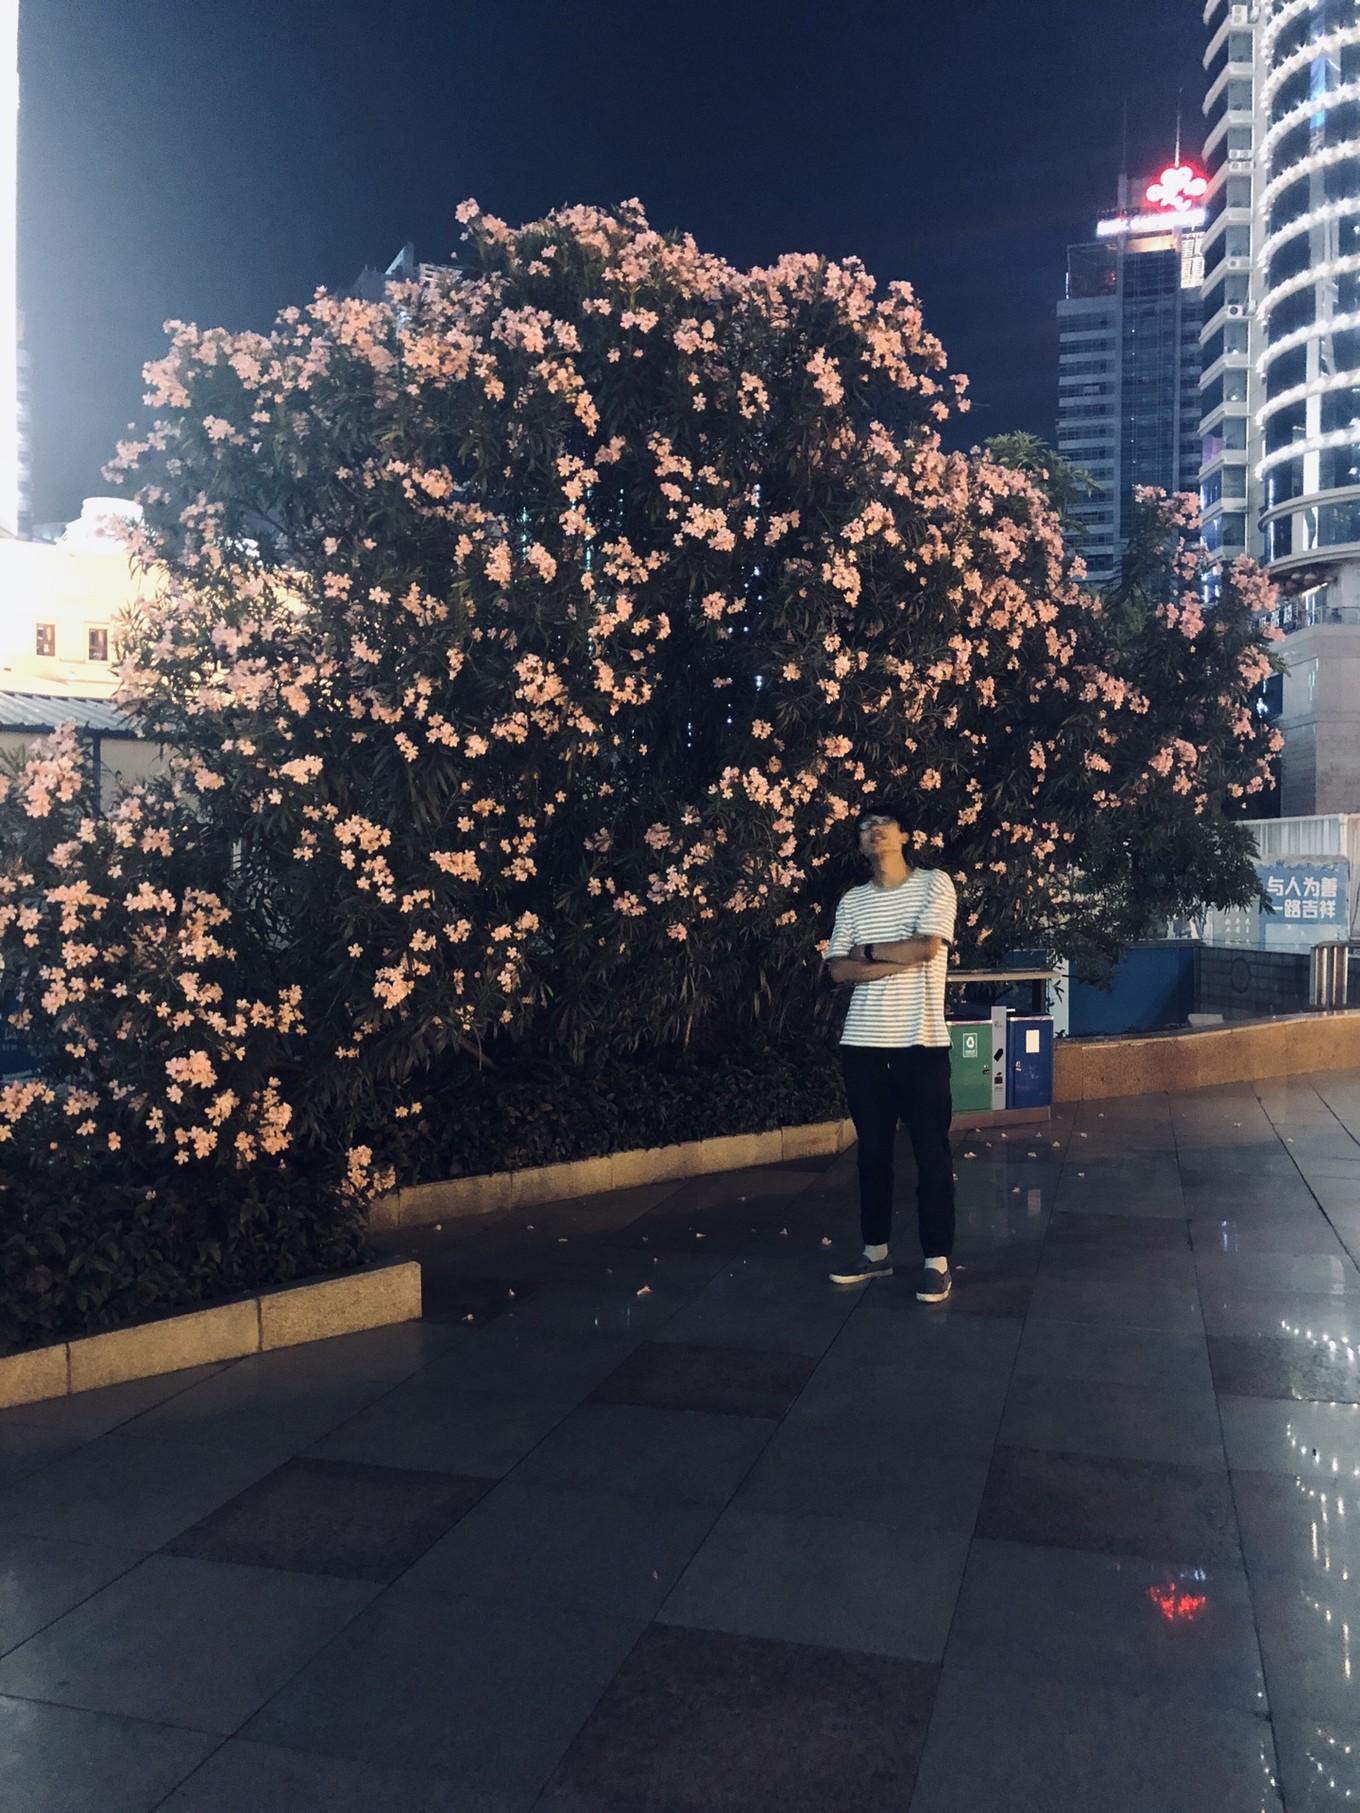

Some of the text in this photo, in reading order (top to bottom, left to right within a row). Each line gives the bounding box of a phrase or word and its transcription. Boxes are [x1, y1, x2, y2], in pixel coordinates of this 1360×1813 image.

[1266, 875, 1338, 897] 与人为善
[1270, 898, 1336, 918] 一路吉祥
